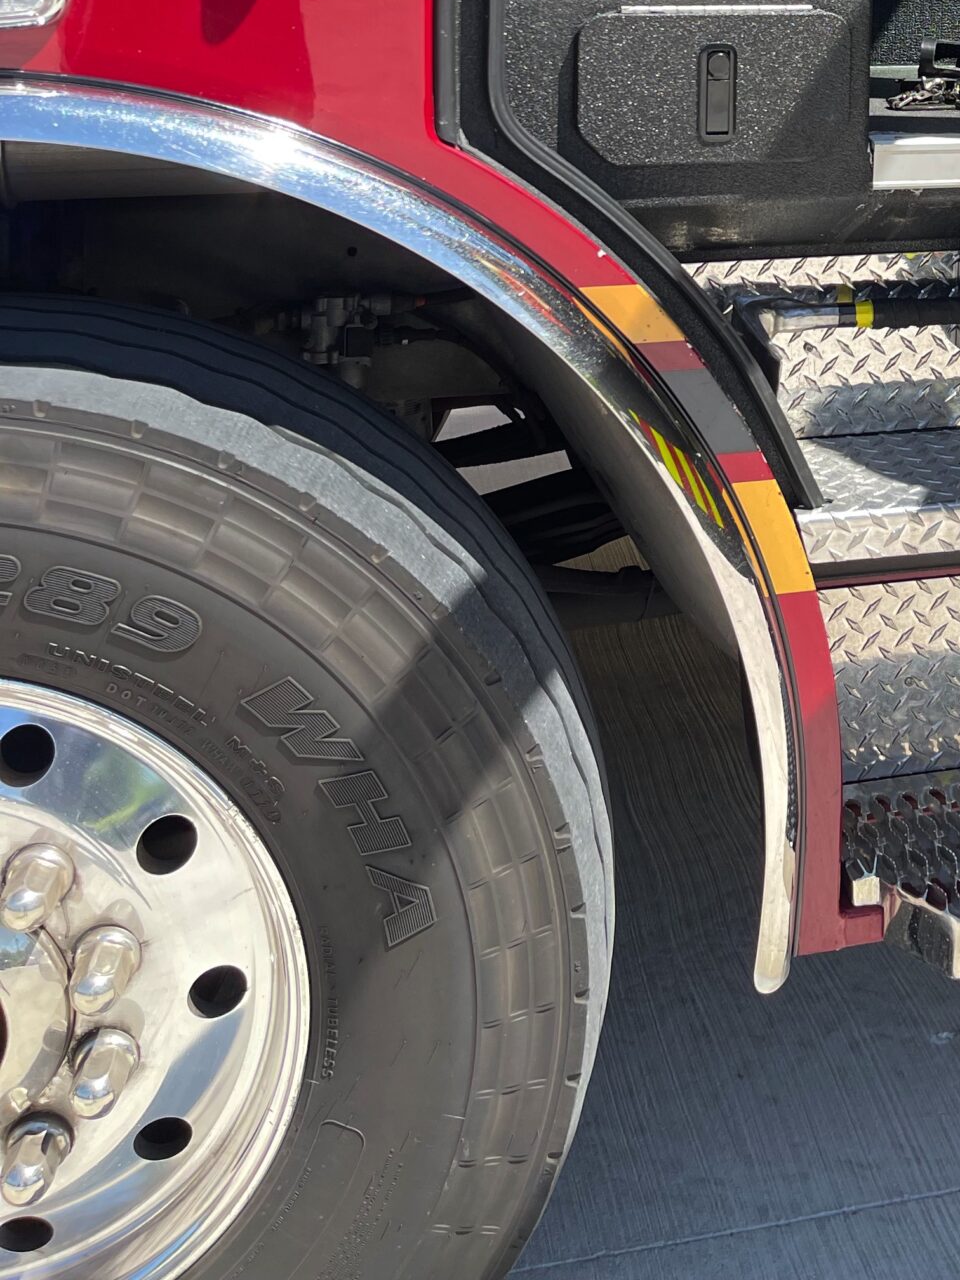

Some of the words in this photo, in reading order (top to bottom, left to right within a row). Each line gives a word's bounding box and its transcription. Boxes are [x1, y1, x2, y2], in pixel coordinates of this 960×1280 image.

[48, 642, 208, 727] UNISTEEL
[106, 682, 147, 707] DOT
[240, 675, 438, 948] WHA
[321, 998, 339, 1081] TUBELESS
